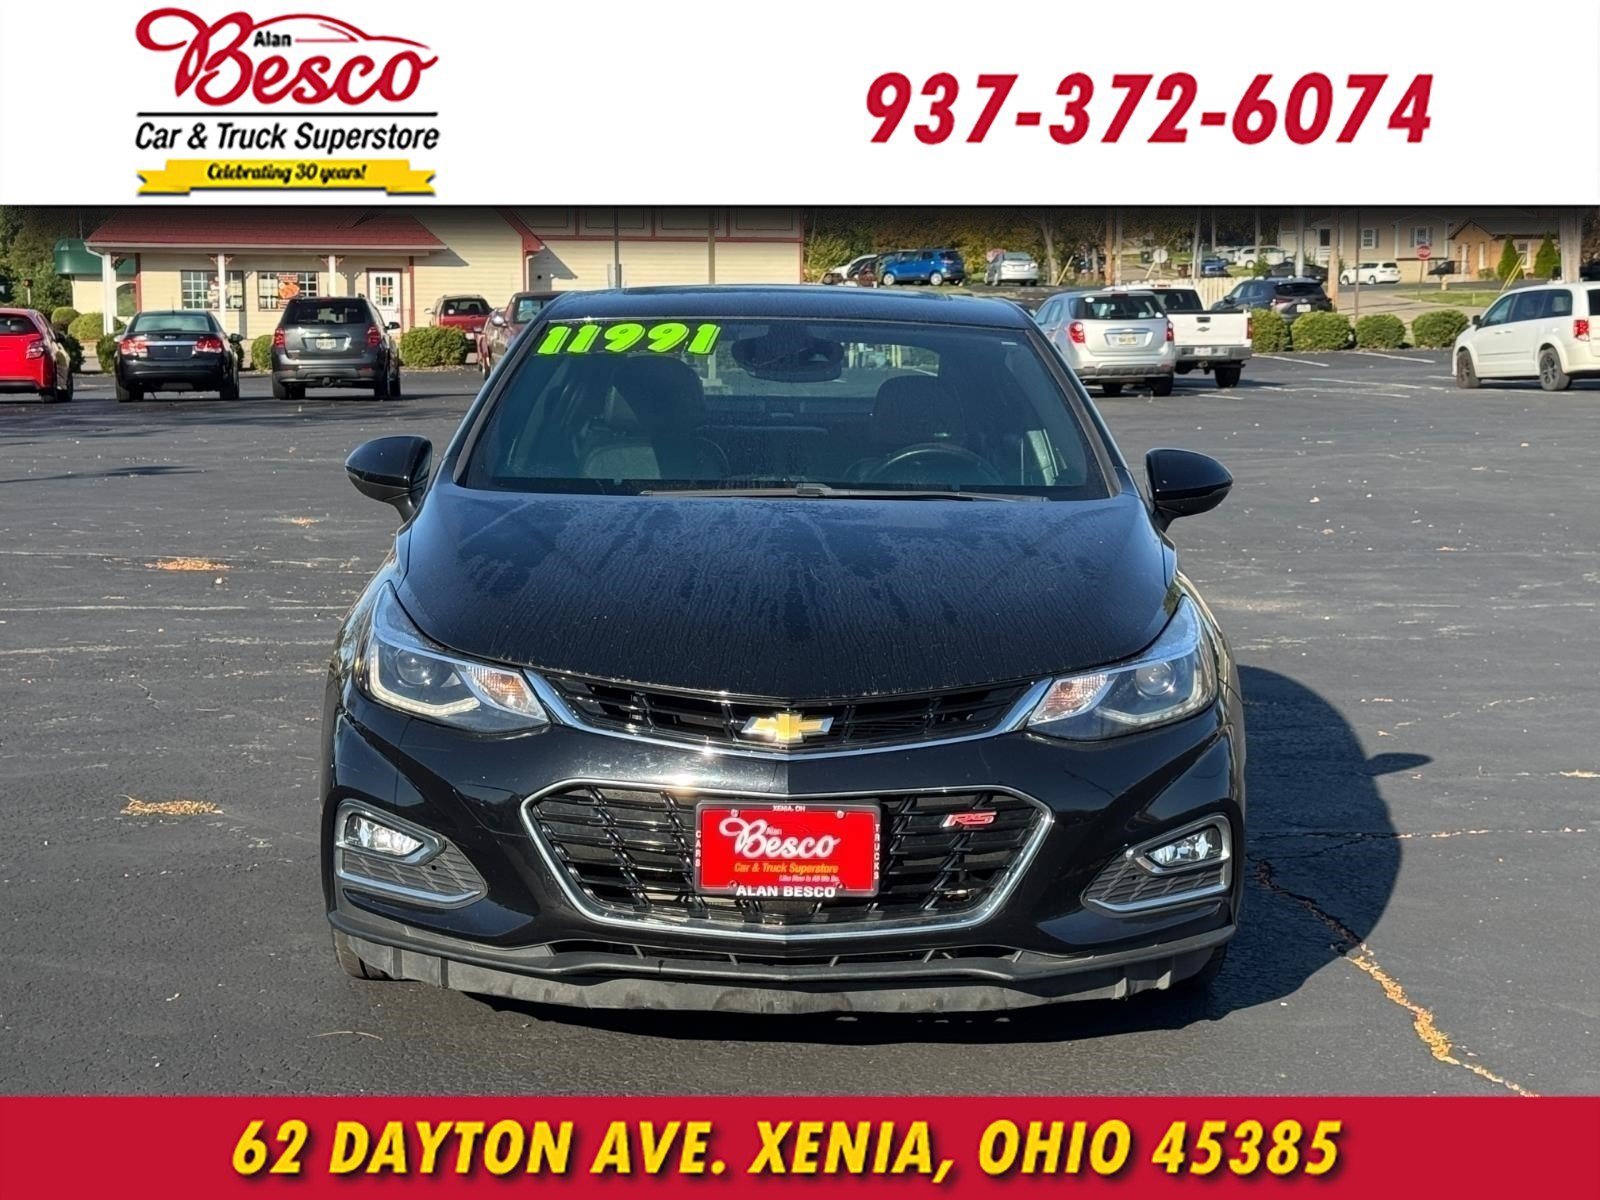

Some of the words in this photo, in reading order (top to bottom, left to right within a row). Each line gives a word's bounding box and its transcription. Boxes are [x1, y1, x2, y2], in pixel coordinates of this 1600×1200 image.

[538, 322, 721, 355] 11991
[942, 811, 997, 827] RS
[718, 816, 841, 859] Besco
[873, 823, 881, 881] TRUCKS
[734, 862, 751, 873] Car
[752, 862, 760, 872] &
[763, 862, 787, 873] Truck
[789, 862, 838, 875] Superstore
[736, 885, 778, 897] ALAN
[783, 886, 836, 898] BESCO
